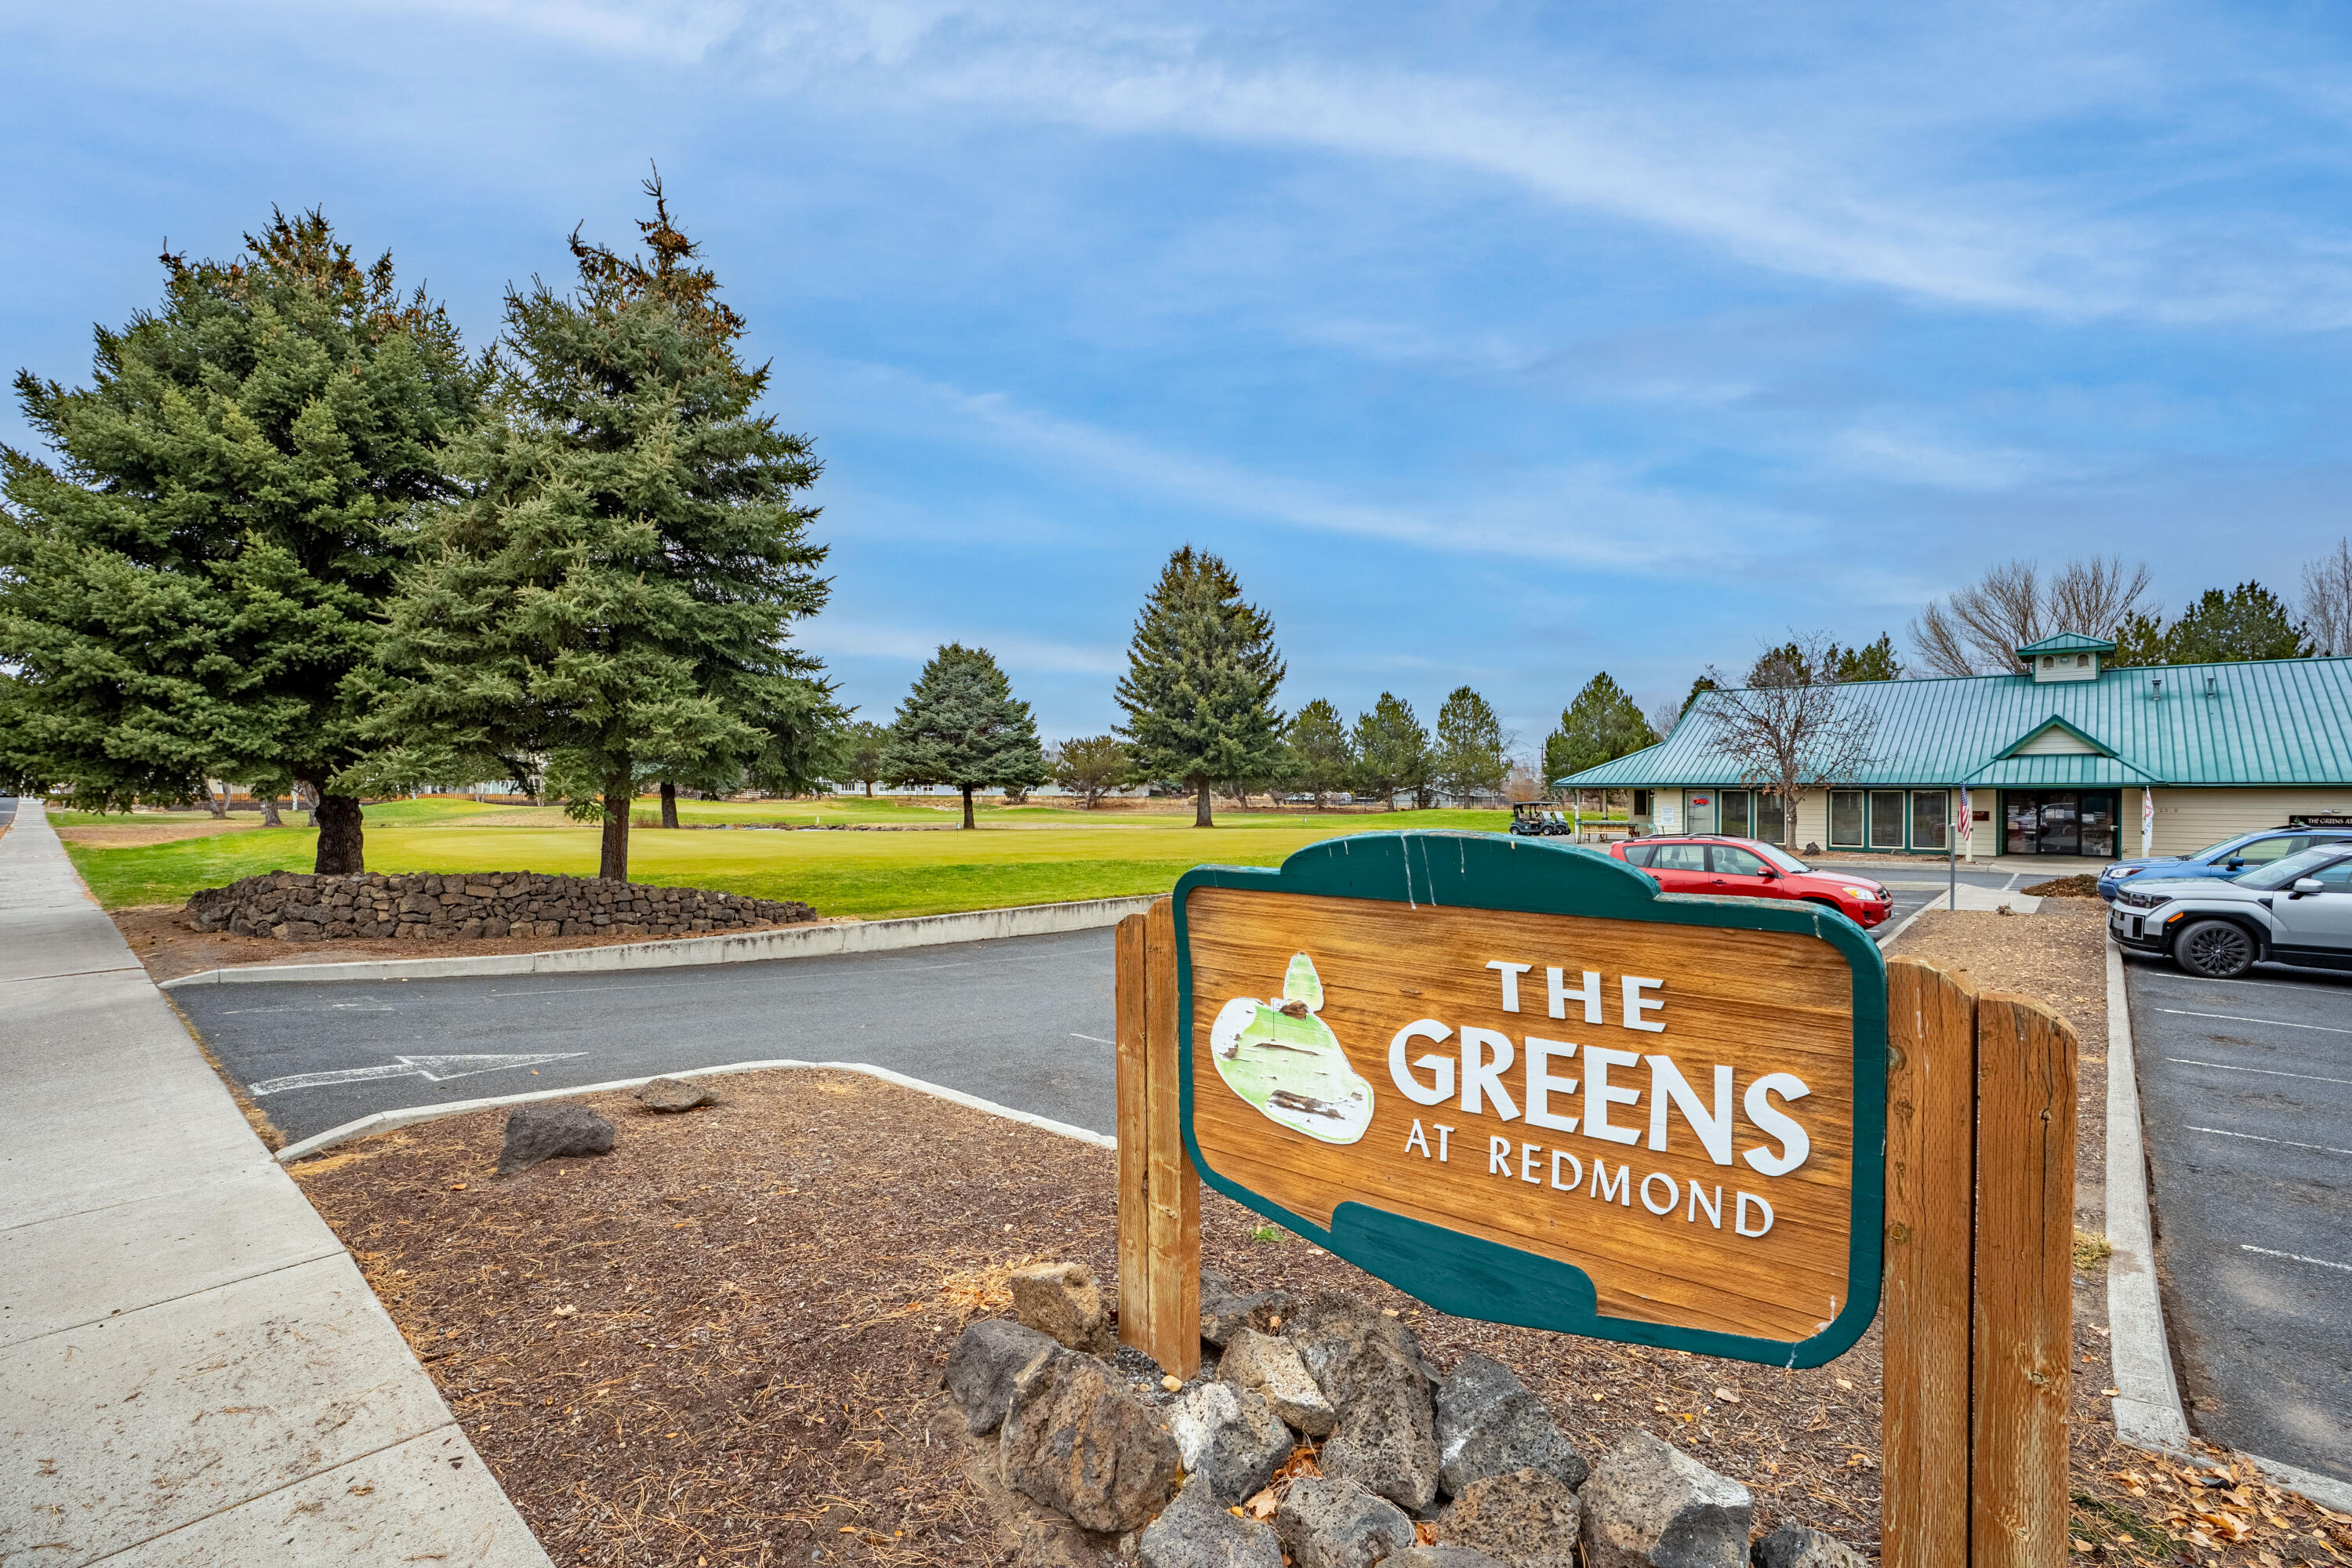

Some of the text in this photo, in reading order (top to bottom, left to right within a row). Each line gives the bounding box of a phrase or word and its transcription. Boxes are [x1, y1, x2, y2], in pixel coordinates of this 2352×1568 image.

[1485, 960, 1666, 1033] THE
[1388, 1018, 1812, 1177] GREENS
[1404, 1118, 1774, 1238] AT REDMOND
